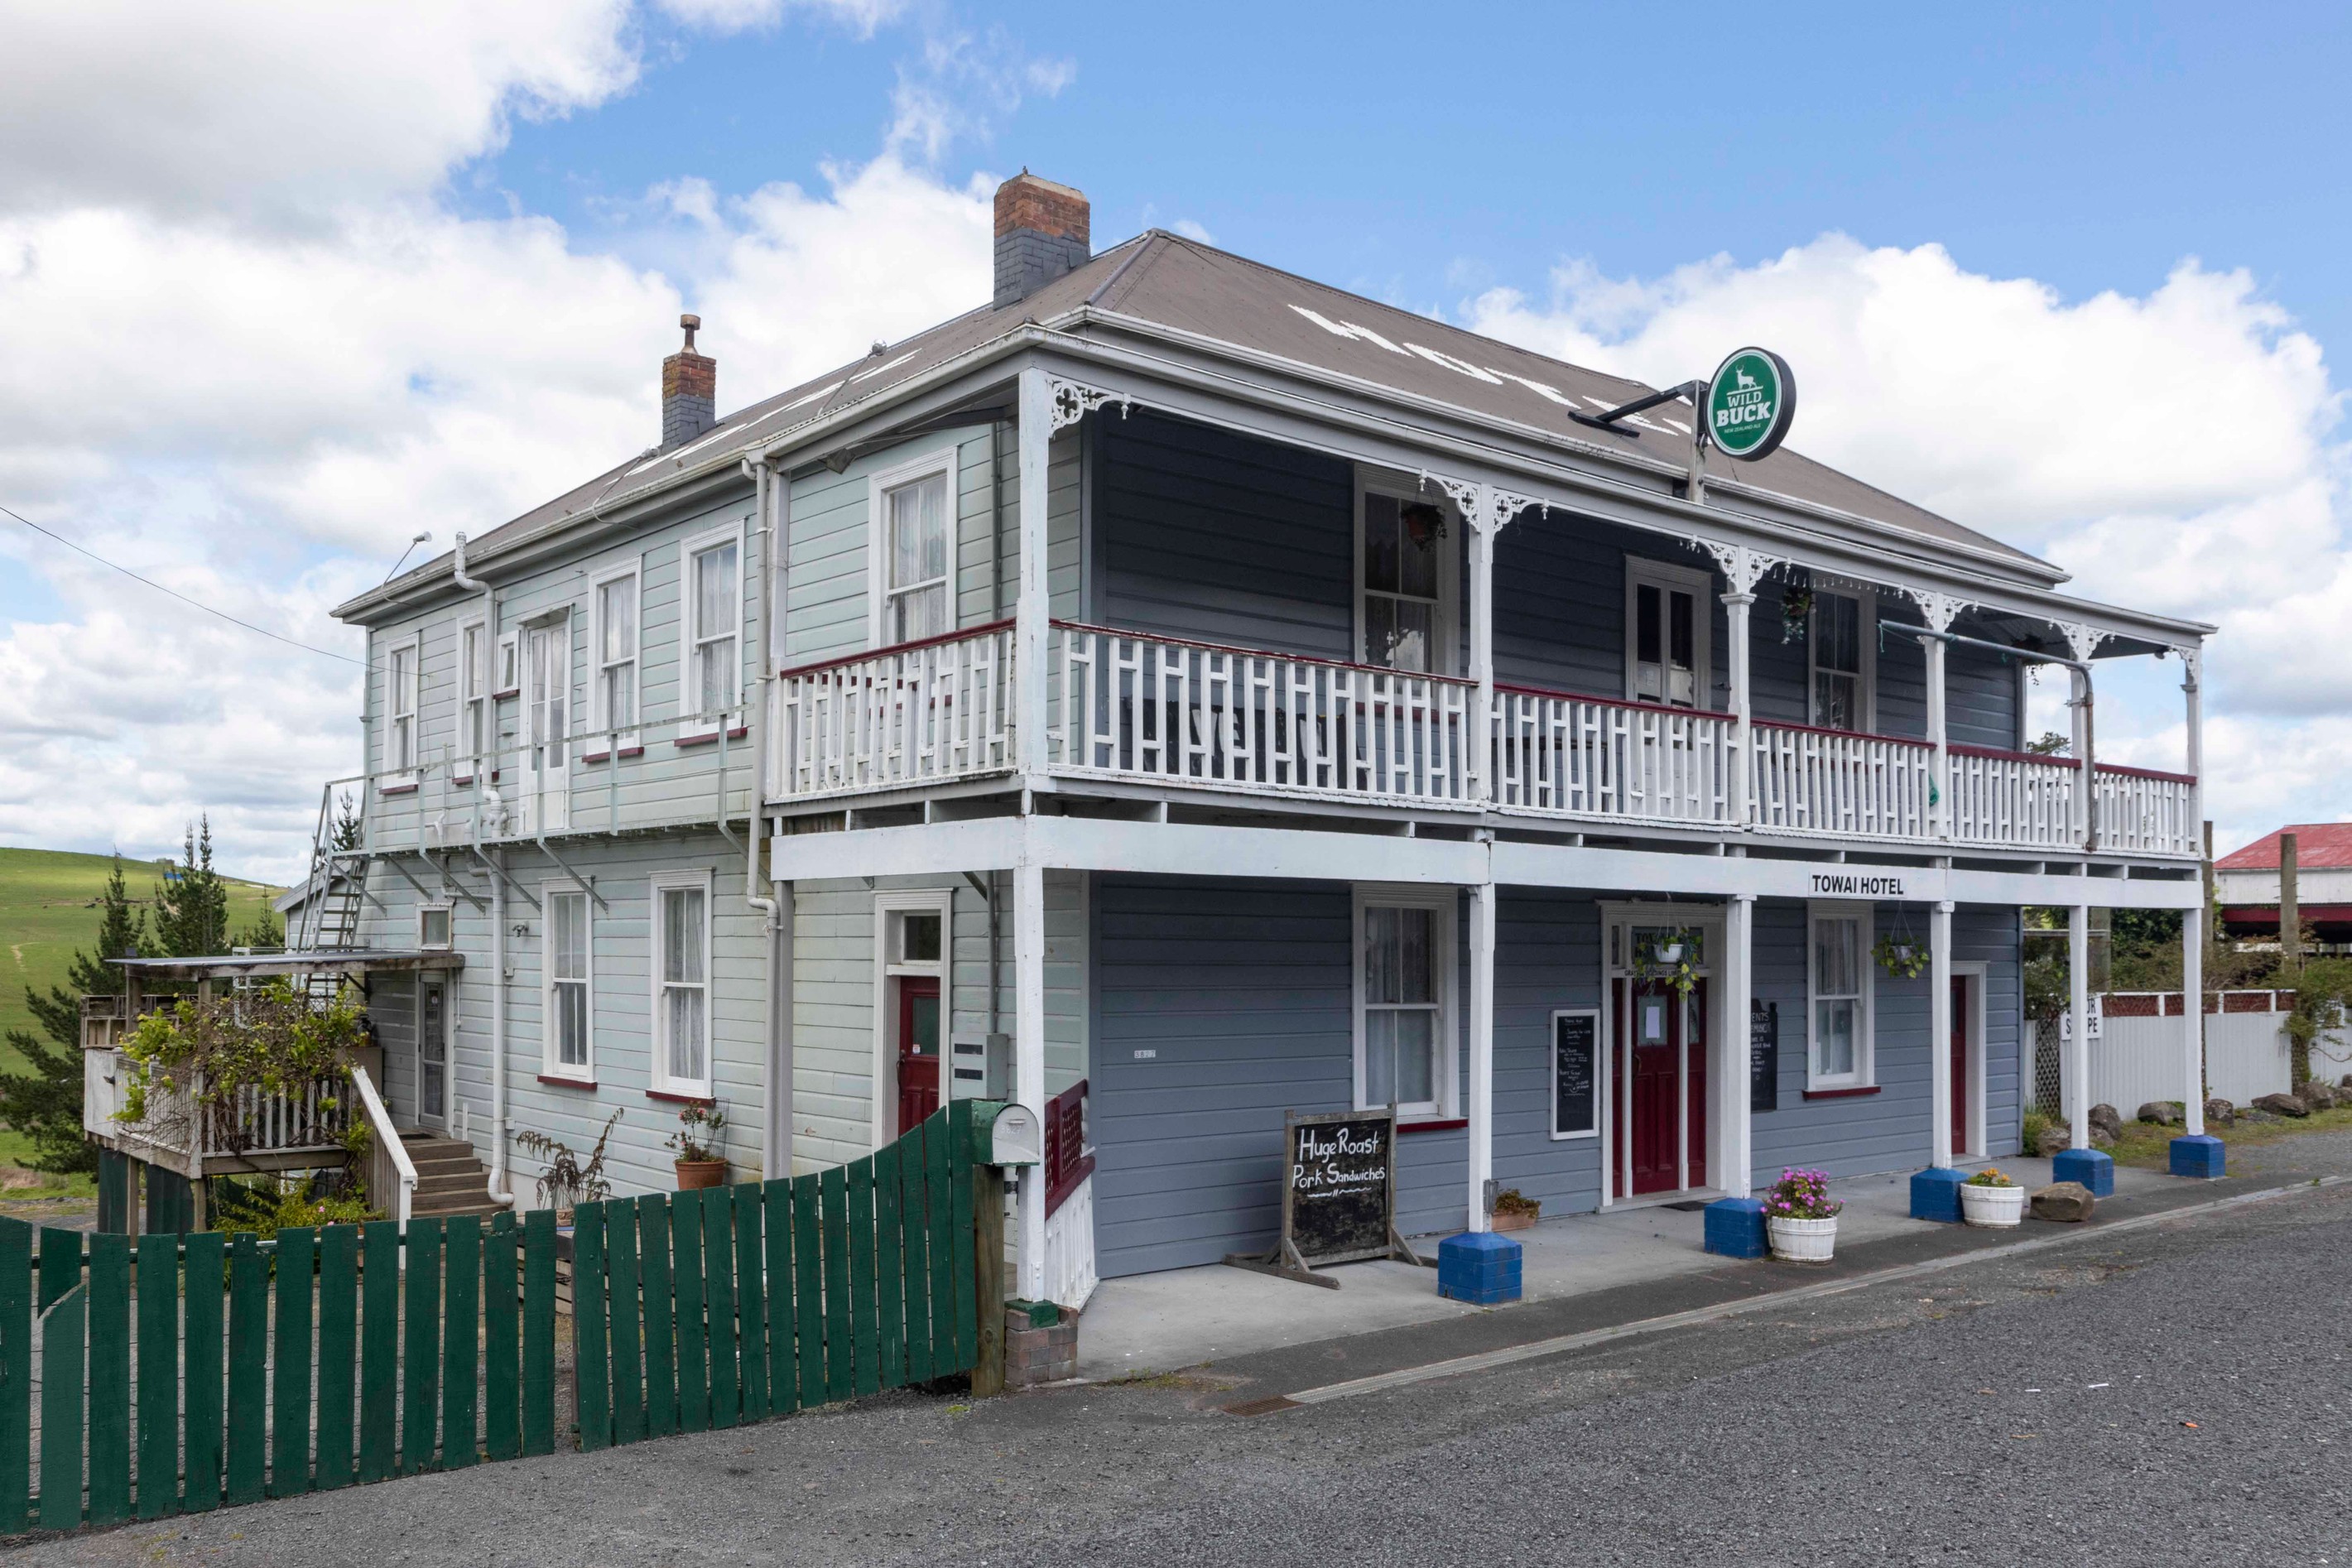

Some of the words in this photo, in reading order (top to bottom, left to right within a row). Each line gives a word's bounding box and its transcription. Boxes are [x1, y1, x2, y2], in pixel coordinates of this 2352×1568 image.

[1726, 391, 1762, 407] WILD
[1716, 402, 1771, 427] BUCK
[1812, 874, 1857, 893] TOWAI
[1861, 878, 1904, 895] HOTEL
[1751, 1012, 1769, 1022] ENTS
[1299, 1128, 1336, 1163] Huge
[1336, 1128, 1379, 1155] Roast
[1292, 1165, 1323, 1188] Pork
[1326, 1162, 1385, 1184] Sandwiches
